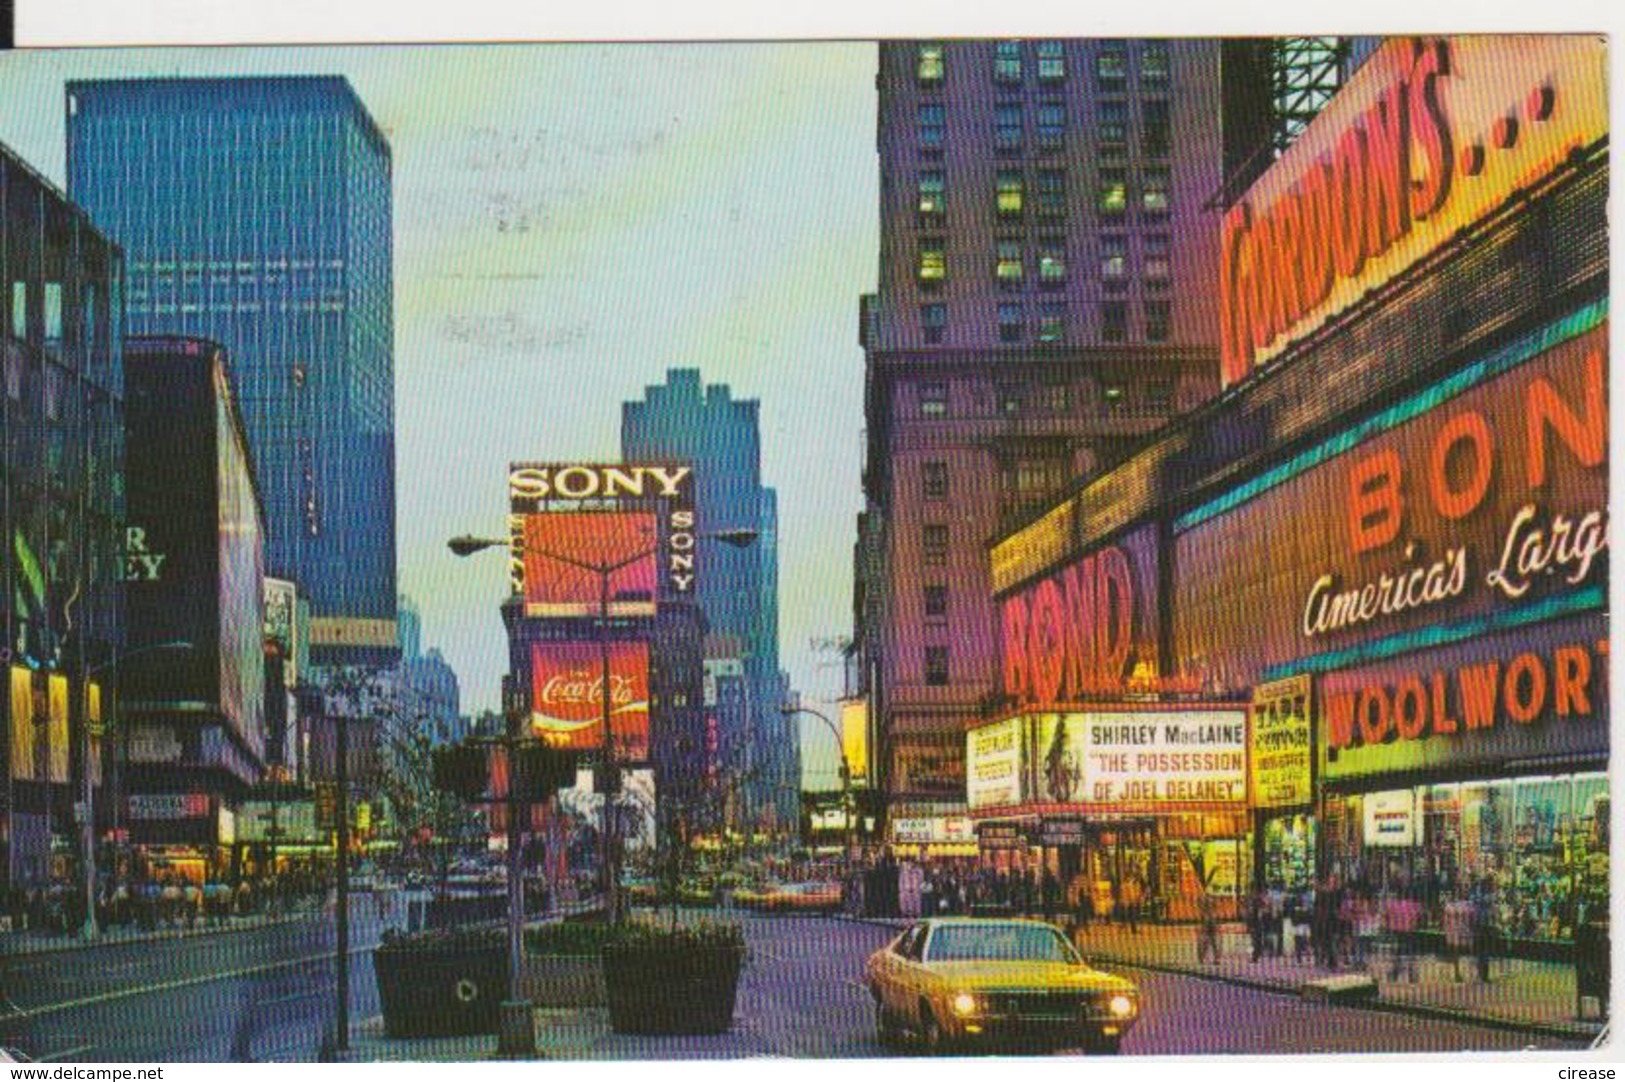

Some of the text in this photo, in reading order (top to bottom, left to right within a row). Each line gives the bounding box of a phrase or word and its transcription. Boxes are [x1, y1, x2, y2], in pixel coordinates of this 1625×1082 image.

[1347, 352, 1605, 554] BON
[509, 466, 690, 498] SONY
[670, 511, 694, 591] SONY
[1004, 547, 1132, 704] BOND
[1091, 724, 1157, 745] SHIRLEY
[1137, 752, 1242, 772] POSSESSION
[1093, 780, 1113, 801] OF
[1119, 780, 1159, 800] JOEL
